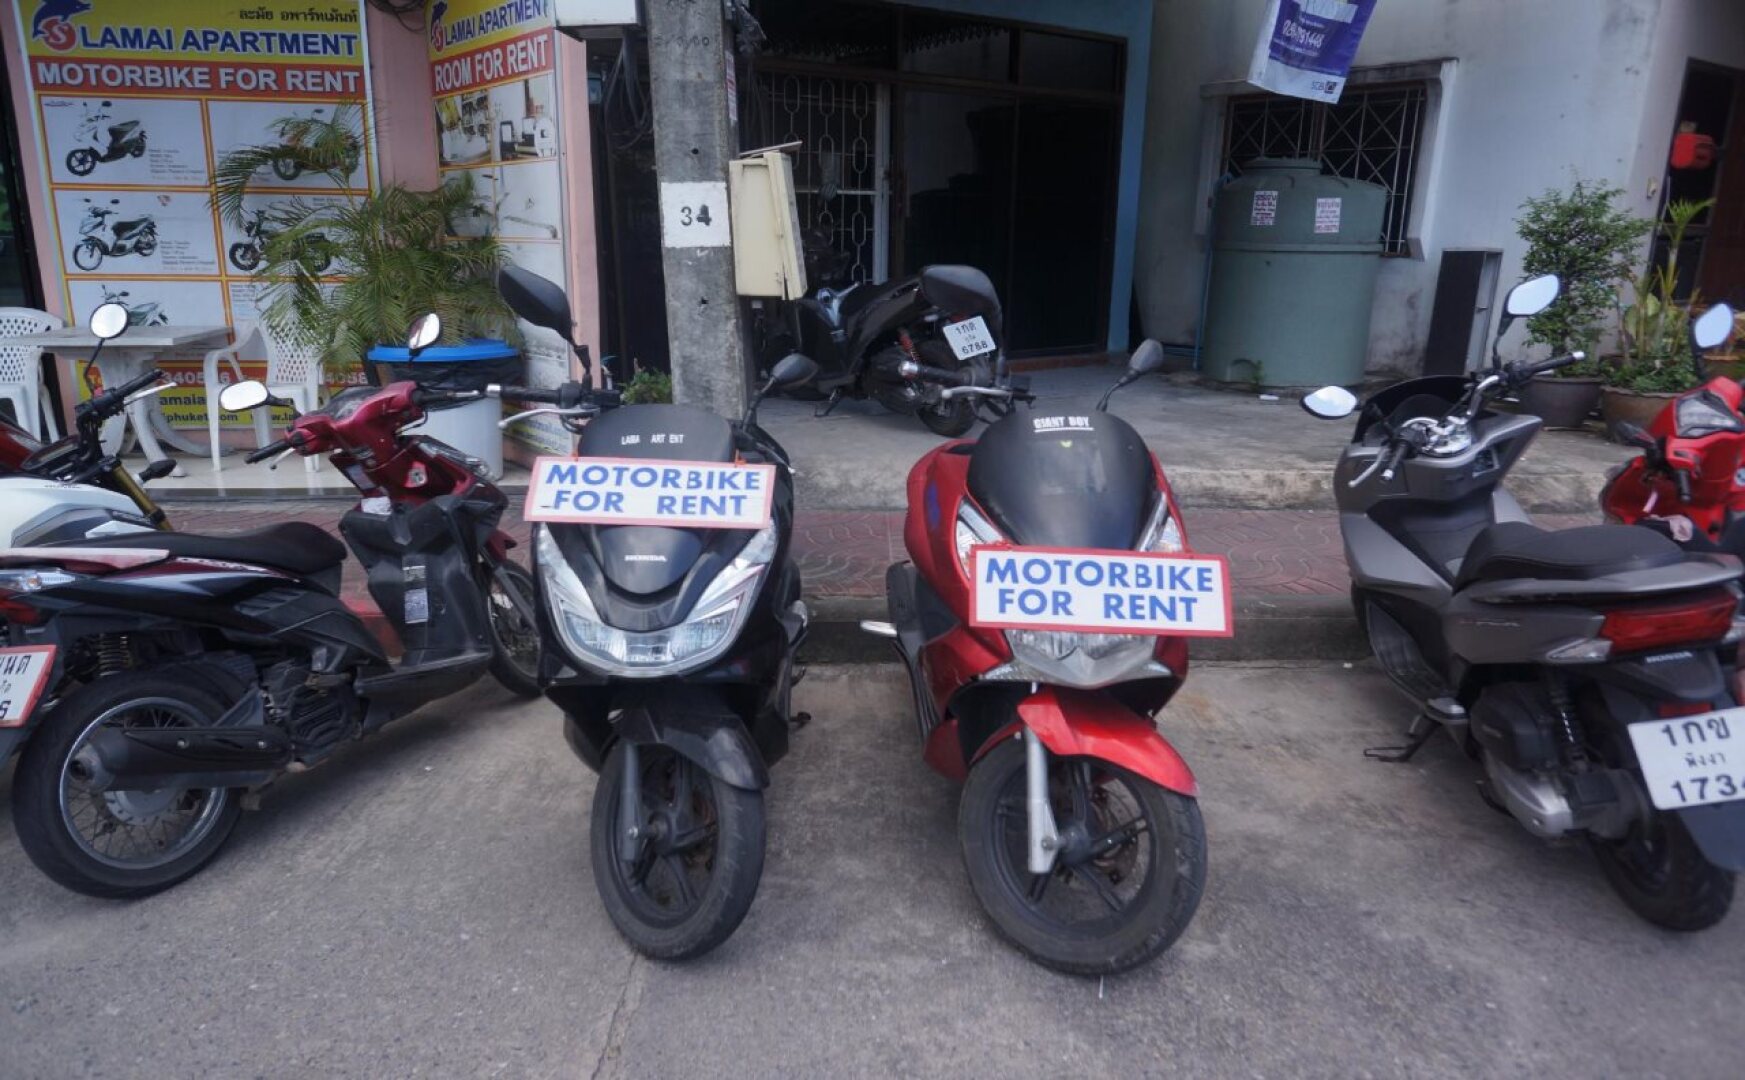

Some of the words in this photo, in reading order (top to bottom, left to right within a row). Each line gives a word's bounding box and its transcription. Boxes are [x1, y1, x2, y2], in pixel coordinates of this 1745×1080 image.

[81, 26, 174, 50] LAMAI
[182, 29, 358, 56] APARTMENT
[445, 18, 475, 46] LAMAI
[37, 62, 212, 89] MOTORBIKE
[219, 67, 279, 91] FOR
[286, 70, 361, 93] RENT
[434, 57, 473, 92] ROOM
[475, 48, 504, 83] FOR
[506, 34, 548, 74] RENT
[680, 204, 712, 226] 34
[546, 464, 762, 491] MOTORBIKE
[553, 490, 625, 513] FOR
[656, 494, 748, 516] RENT
[985, 558, 1214, 592] MOTORBIKE
[998, 588, 1074, 616] FOR
[1103, 592, 1198, 622] RENT
